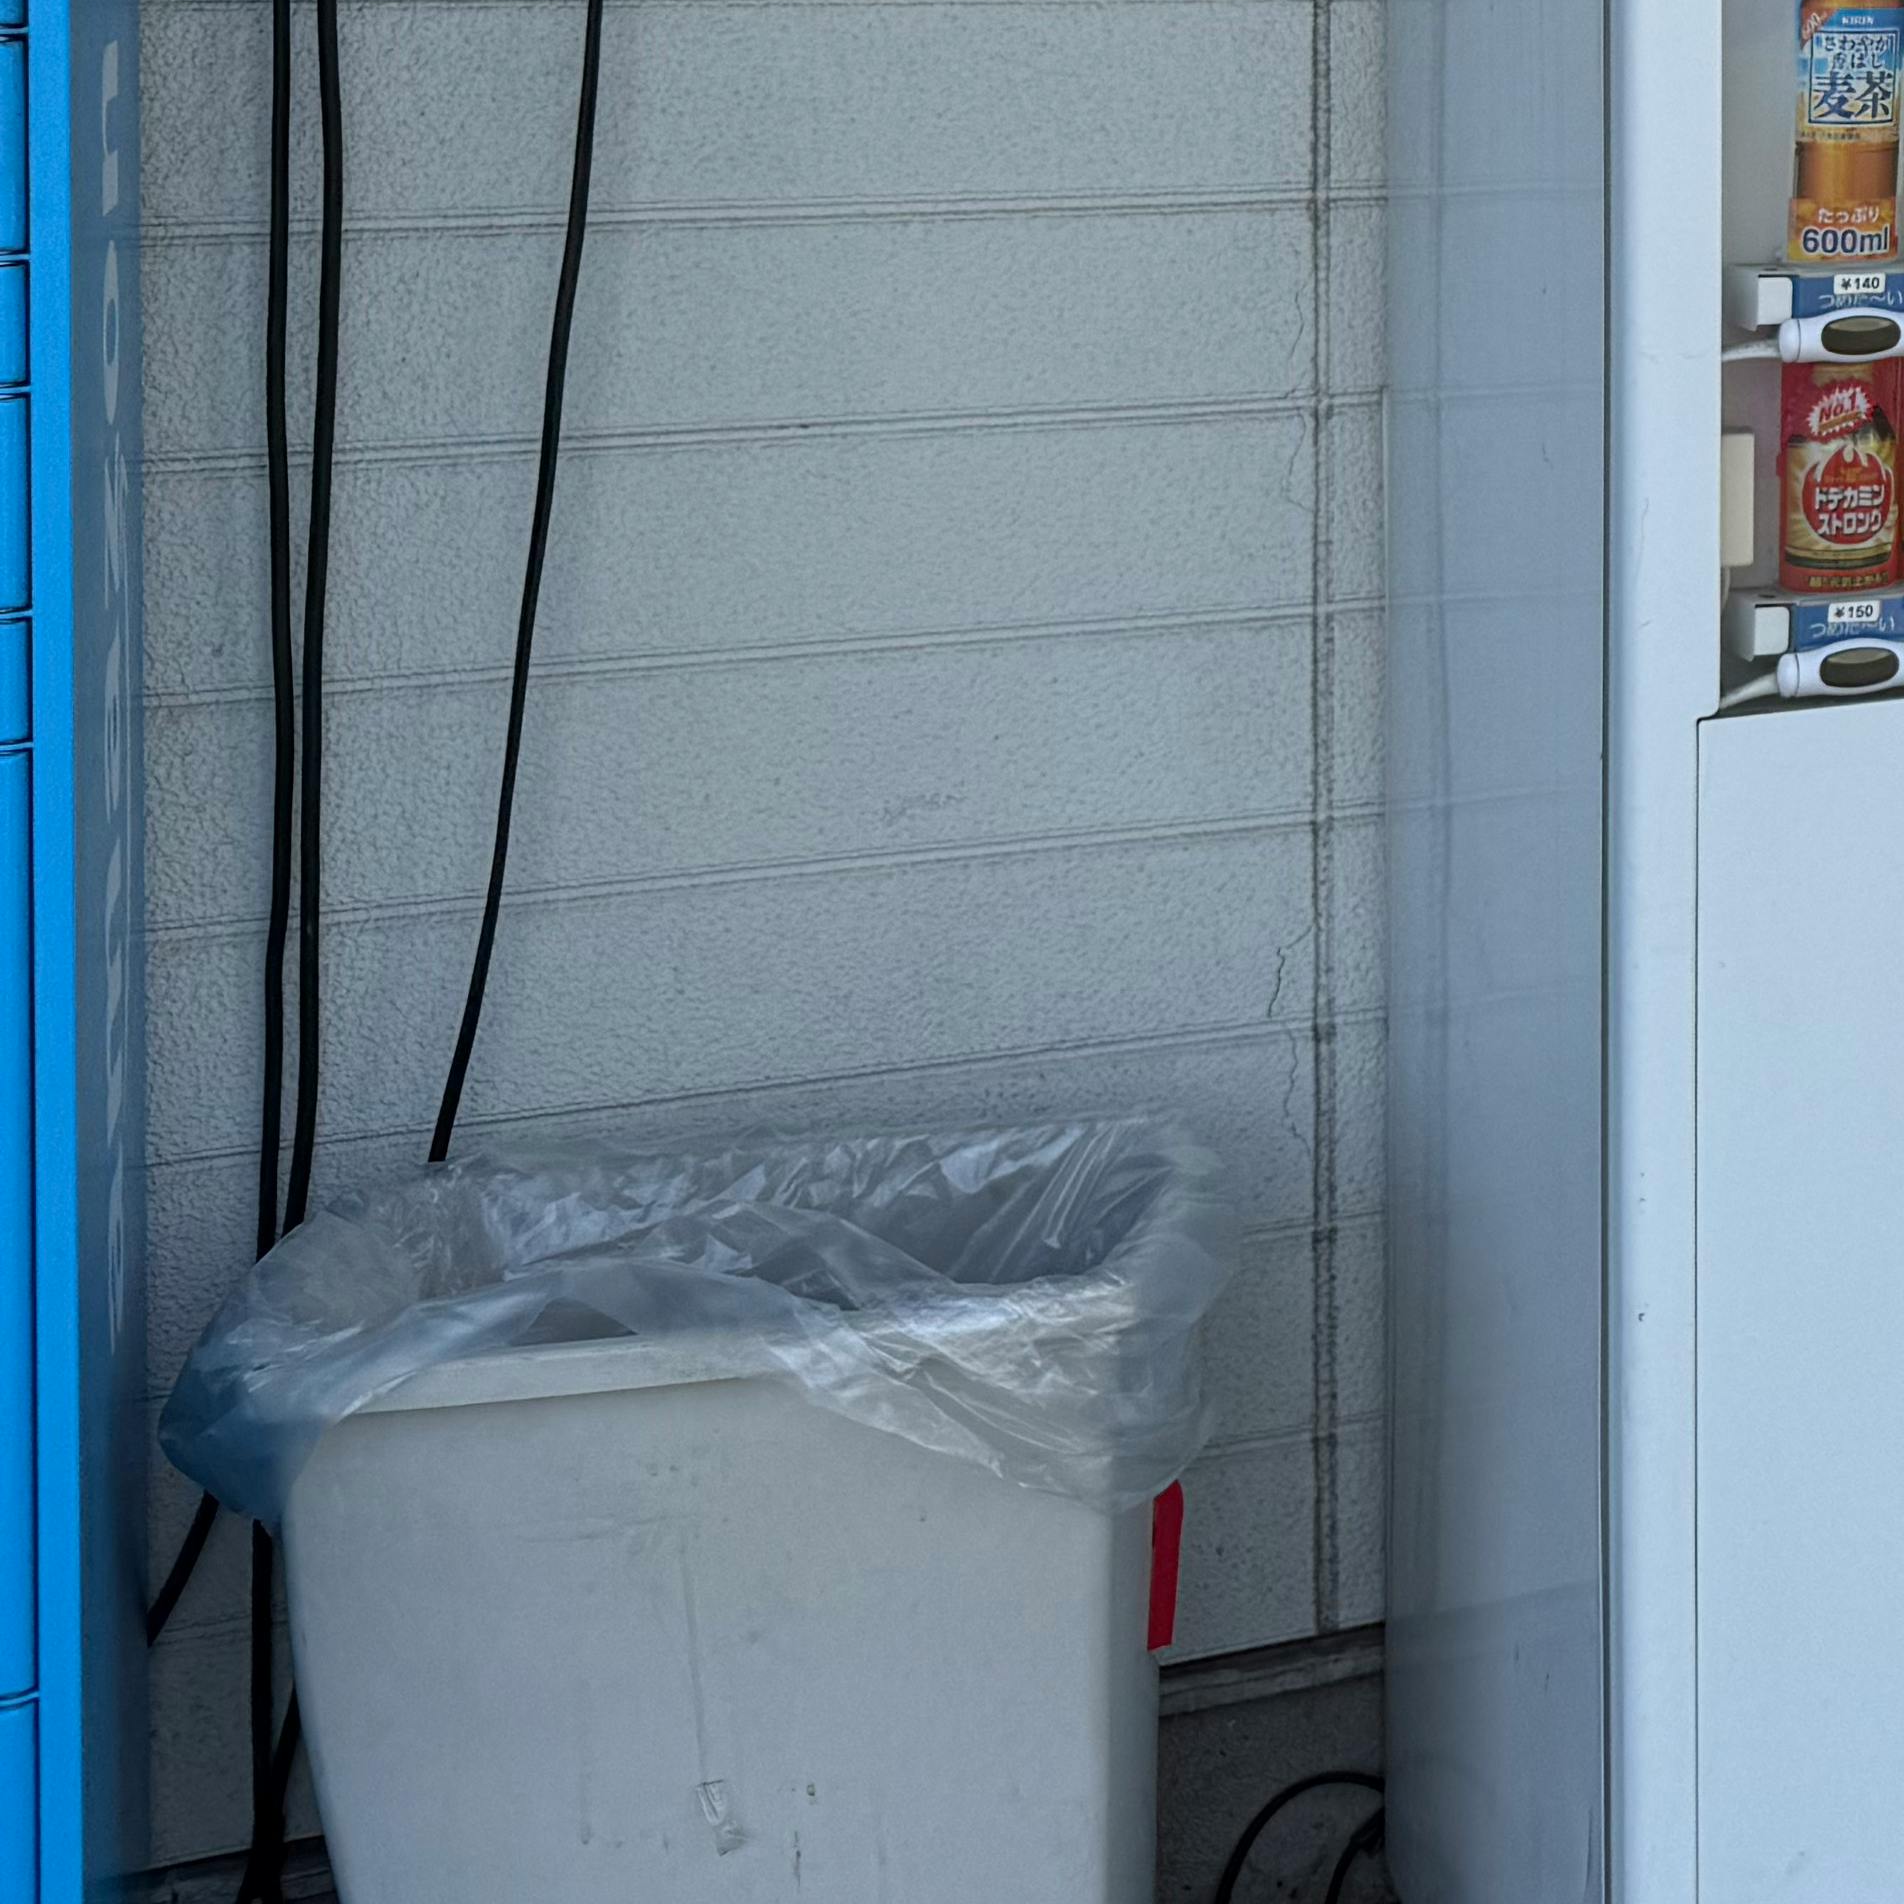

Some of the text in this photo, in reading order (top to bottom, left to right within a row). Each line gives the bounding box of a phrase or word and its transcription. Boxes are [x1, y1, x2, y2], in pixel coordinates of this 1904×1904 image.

[1813, 70, 1894, 120] 麦茶
[1818, 206, 1880, 225] たっぷり
[1801, 224, 1891, 255] 600ml
[1840, 277, 1881, 290] ¥140
[1814, 484, 1885, 510] ドデカミン
[1817, 511, 1882, 536] ストロング
